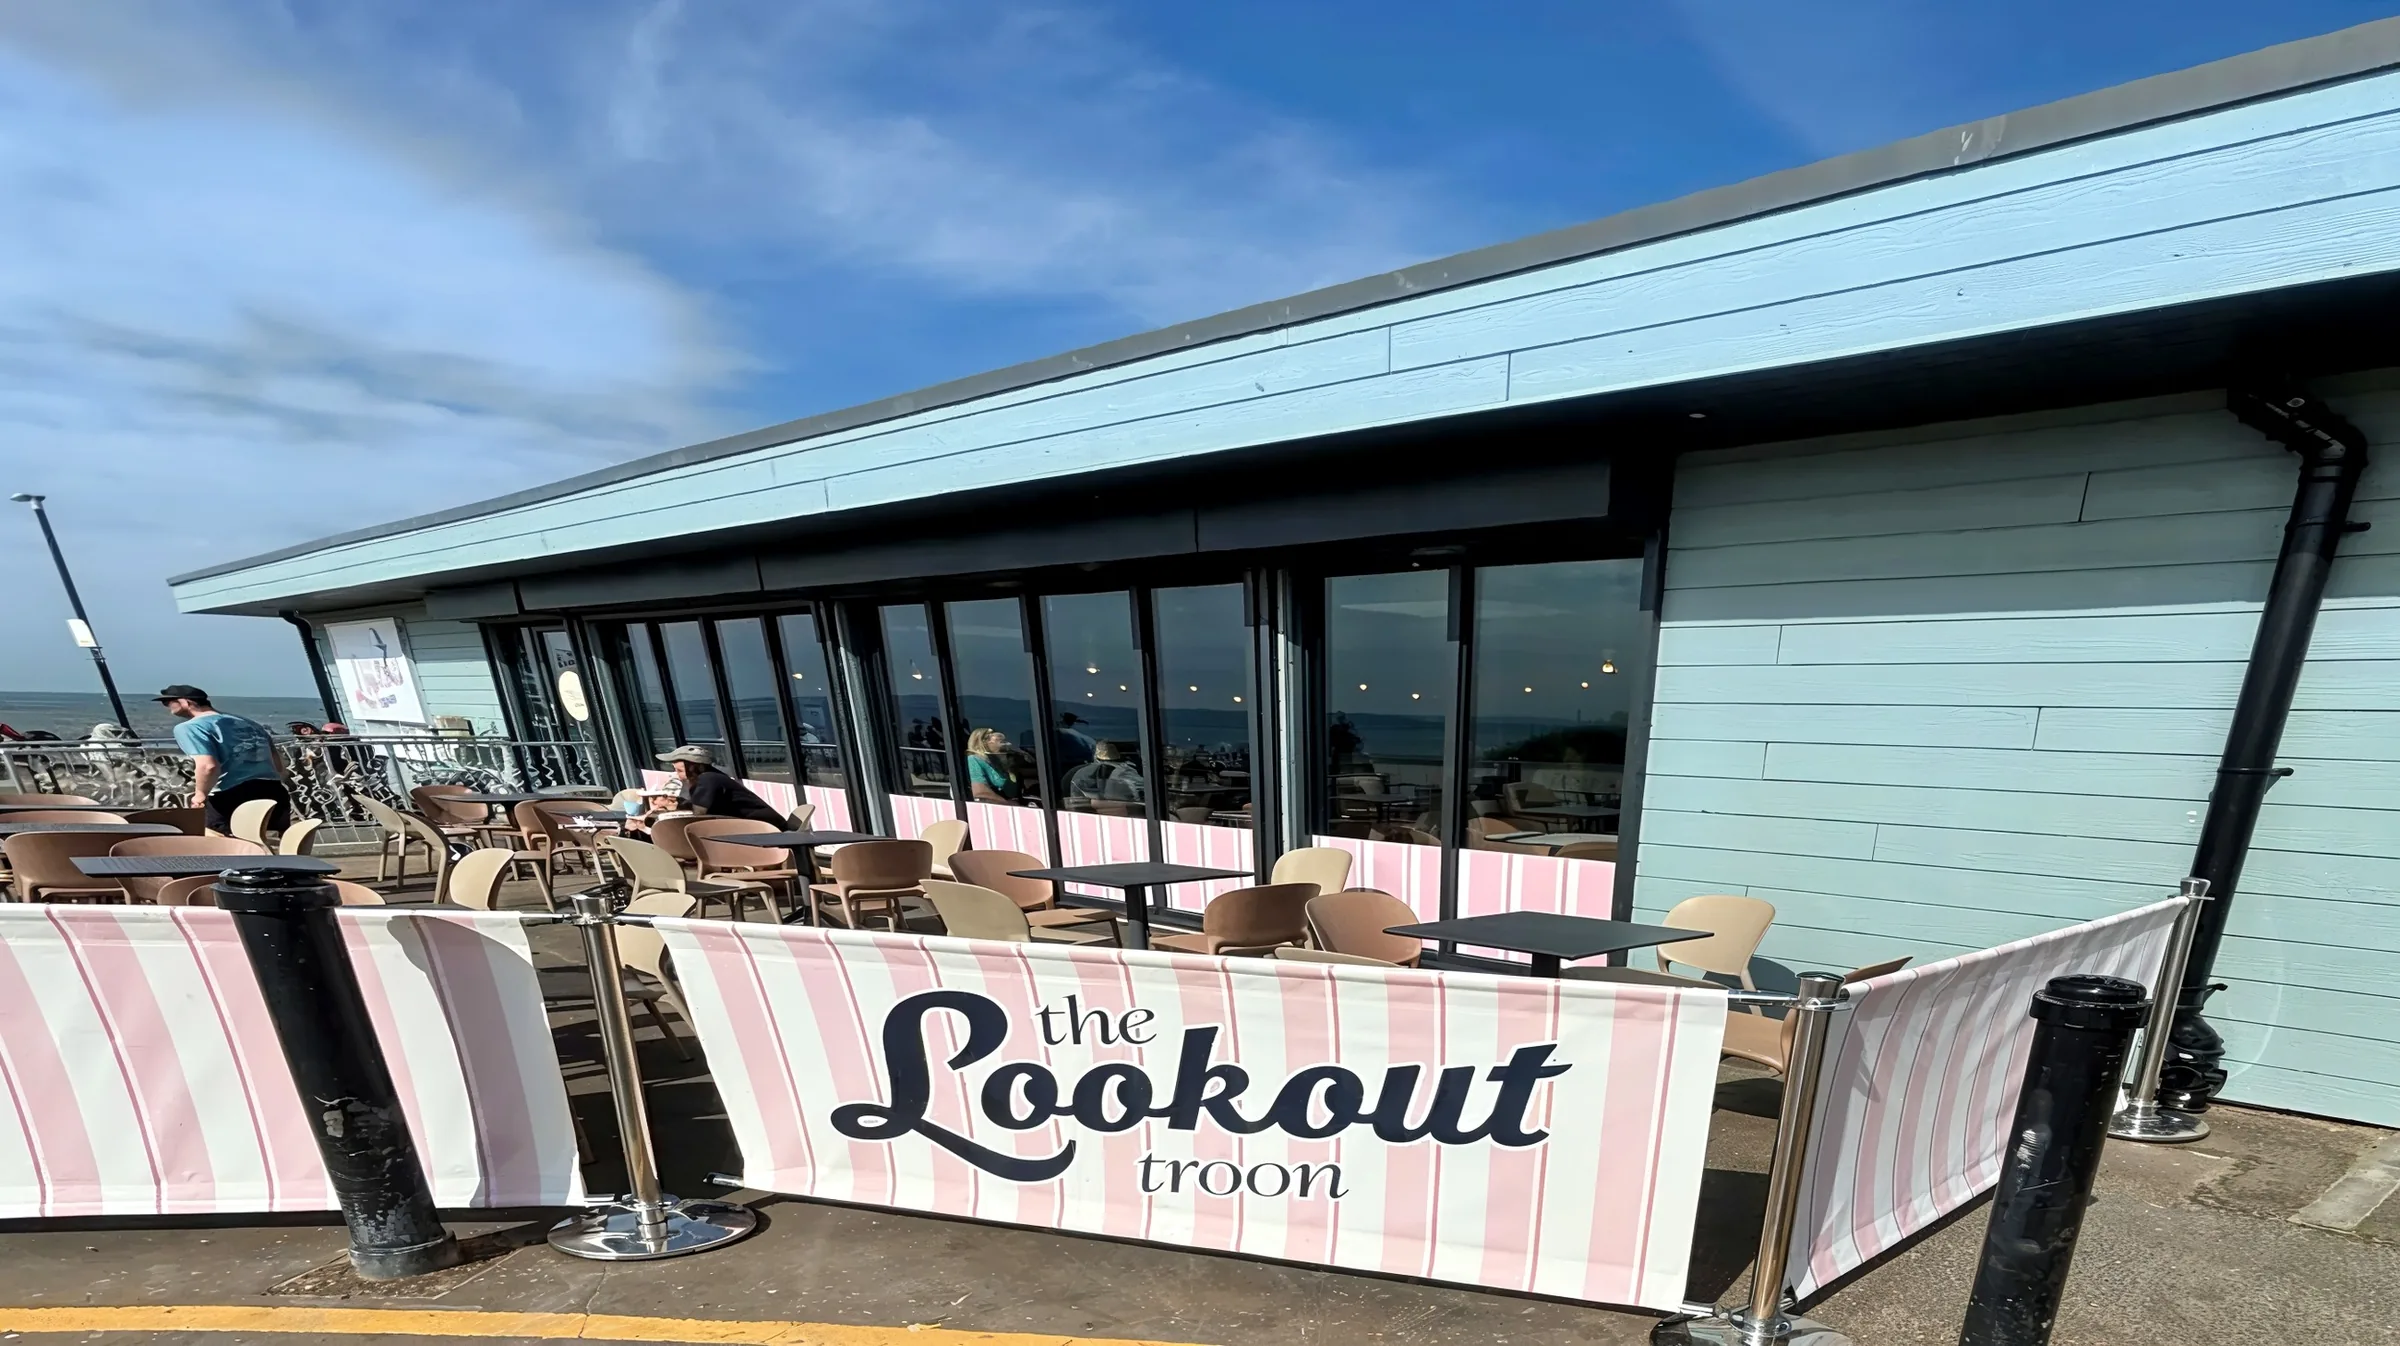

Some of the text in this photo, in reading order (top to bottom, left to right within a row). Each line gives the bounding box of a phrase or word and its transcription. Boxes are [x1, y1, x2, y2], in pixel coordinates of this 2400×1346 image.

[1035, 995, 1157, 1046] the
[831, 990, 1573, 1182] Lookout
[1138, 1153, 1349, 1199] troon
